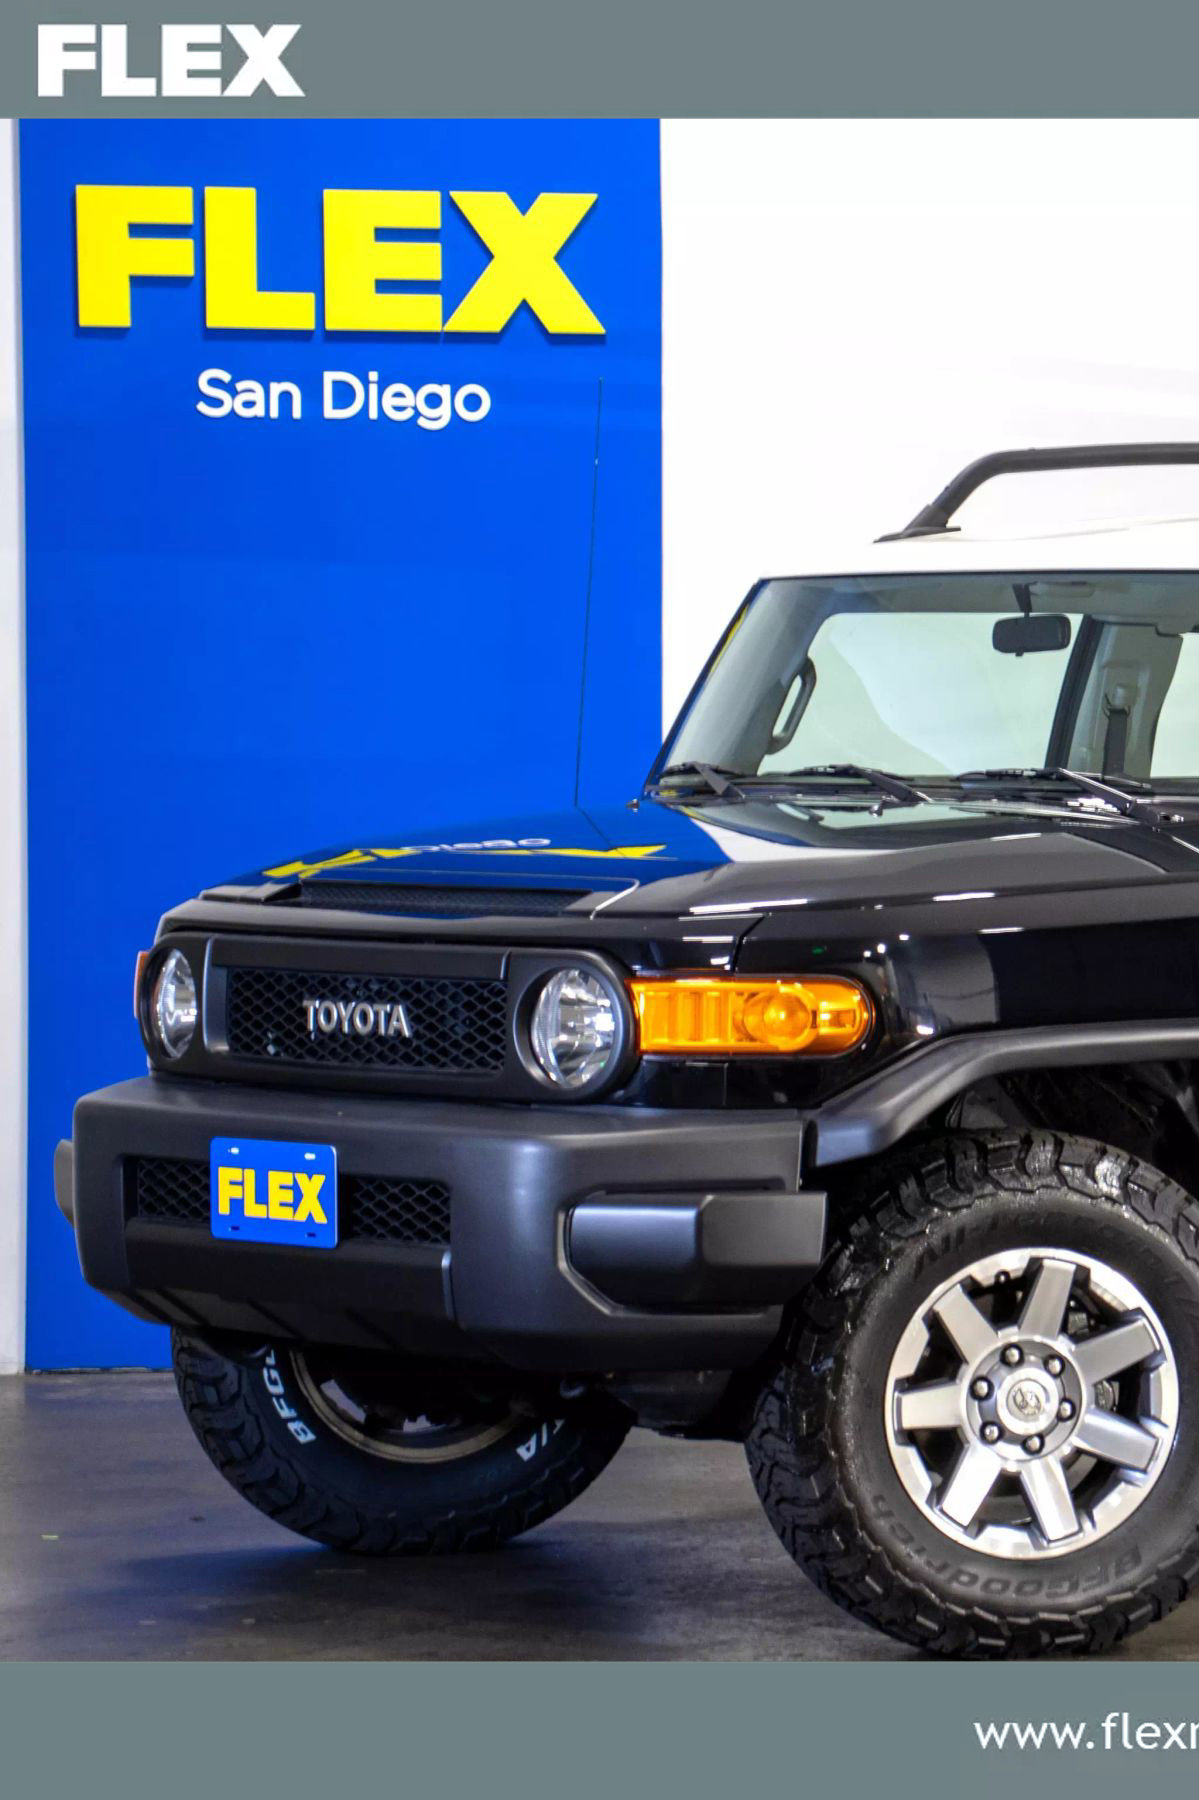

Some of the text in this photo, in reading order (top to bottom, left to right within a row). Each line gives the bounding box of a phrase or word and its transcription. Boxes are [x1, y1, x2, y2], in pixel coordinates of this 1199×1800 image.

[75, 184, 606, 336] FLEX
[196, 369, 491, 430] San Diego
[303, 1000, 413, 1038] TOYOTA
[218, 1166, 328, 1224] FLEX
[871, 1494, 1143, 1598] BFGoodrich
